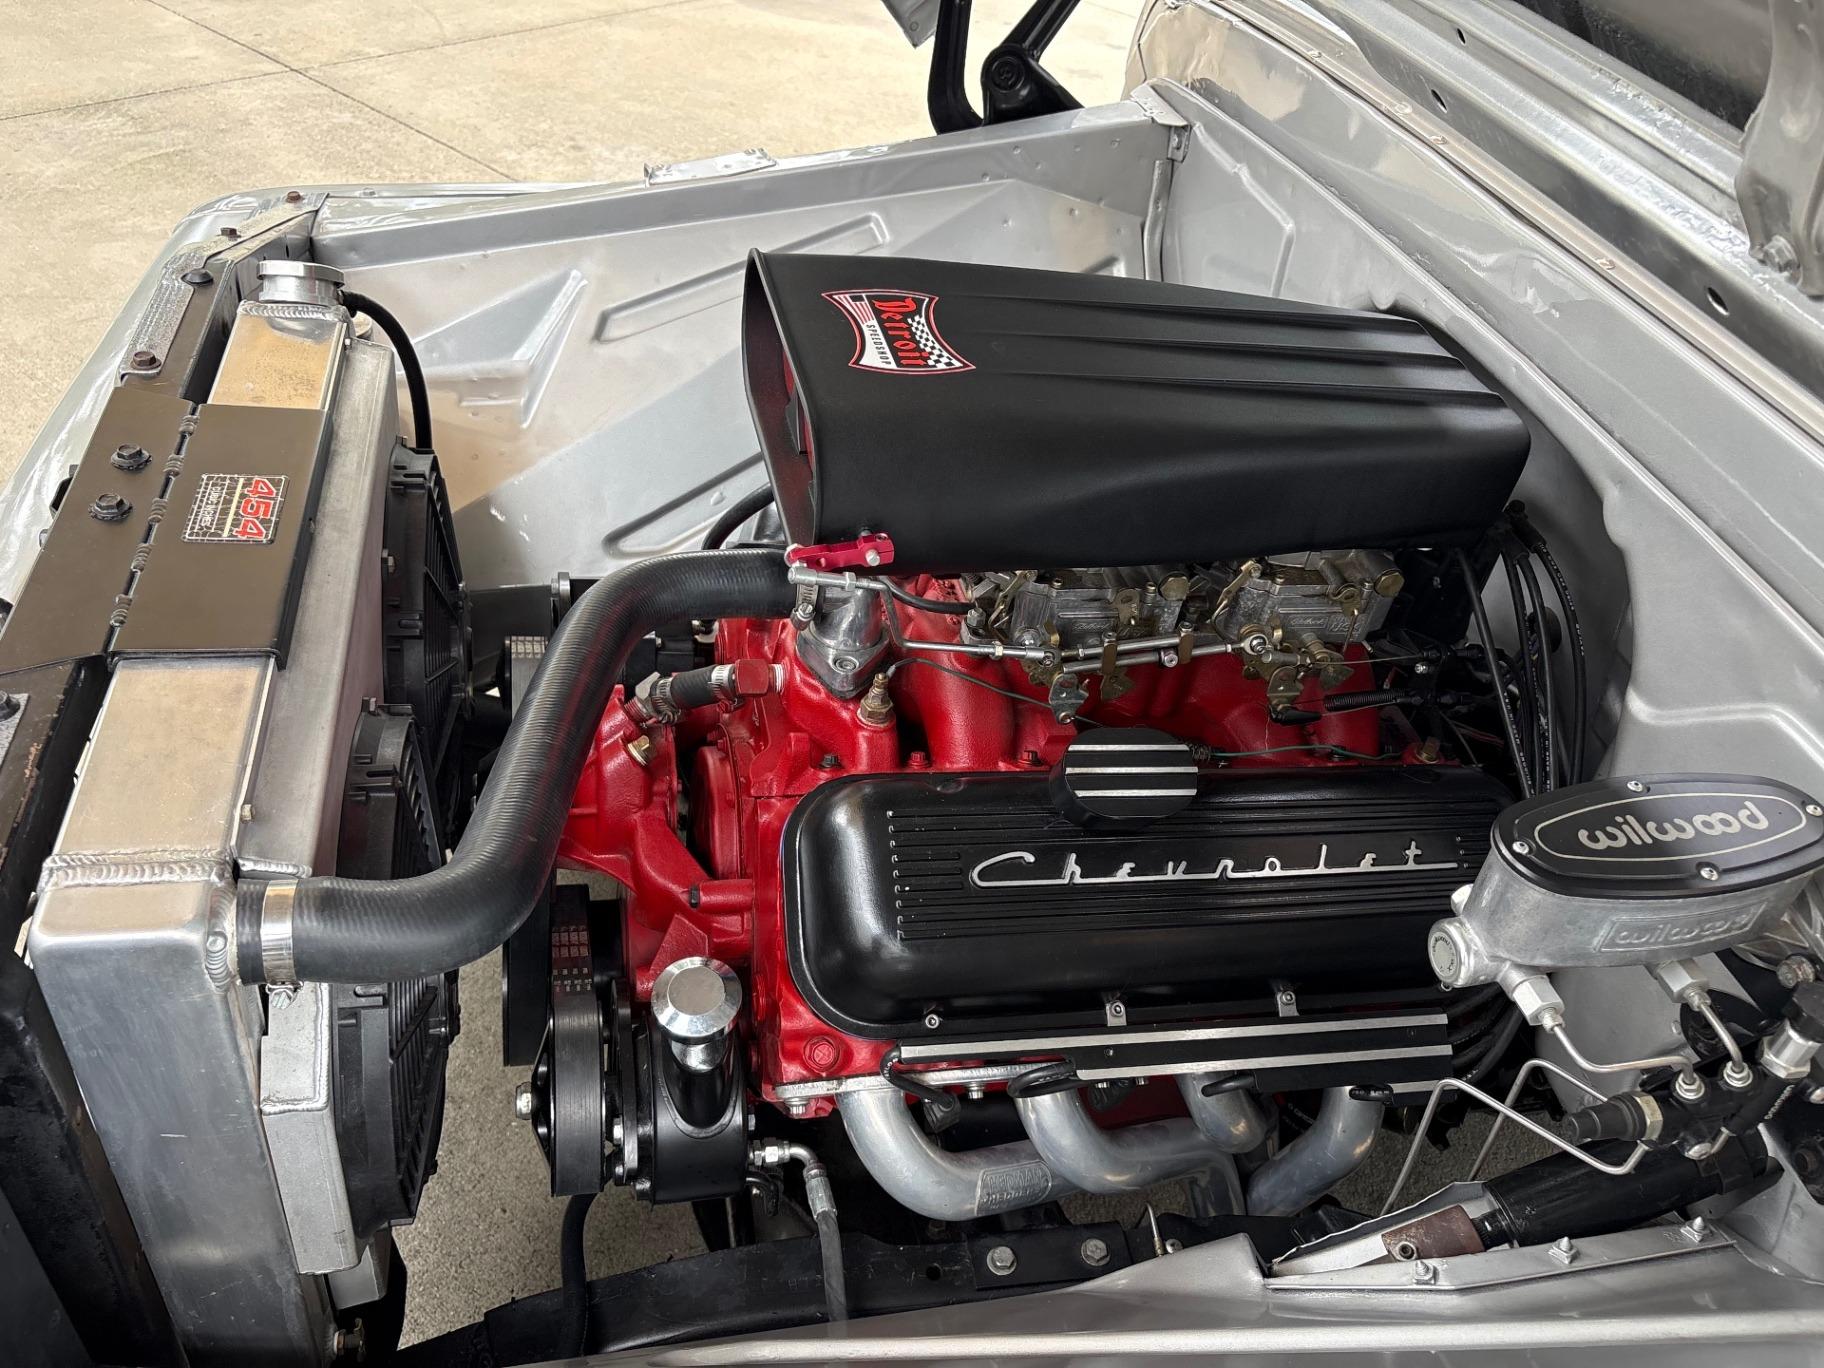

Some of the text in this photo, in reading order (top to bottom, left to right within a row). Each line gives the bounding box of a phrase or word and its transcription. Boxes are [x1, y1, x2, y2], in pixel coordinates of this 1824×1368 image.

[872, 297, 930, 366] Detroit
[233, 478, 276, 538] 454
[1577, 800, 1769, 851] wilwood
[968, 841, 1459, 888] Chevrolet
[1613, 912, 1751, 945] wilwood
